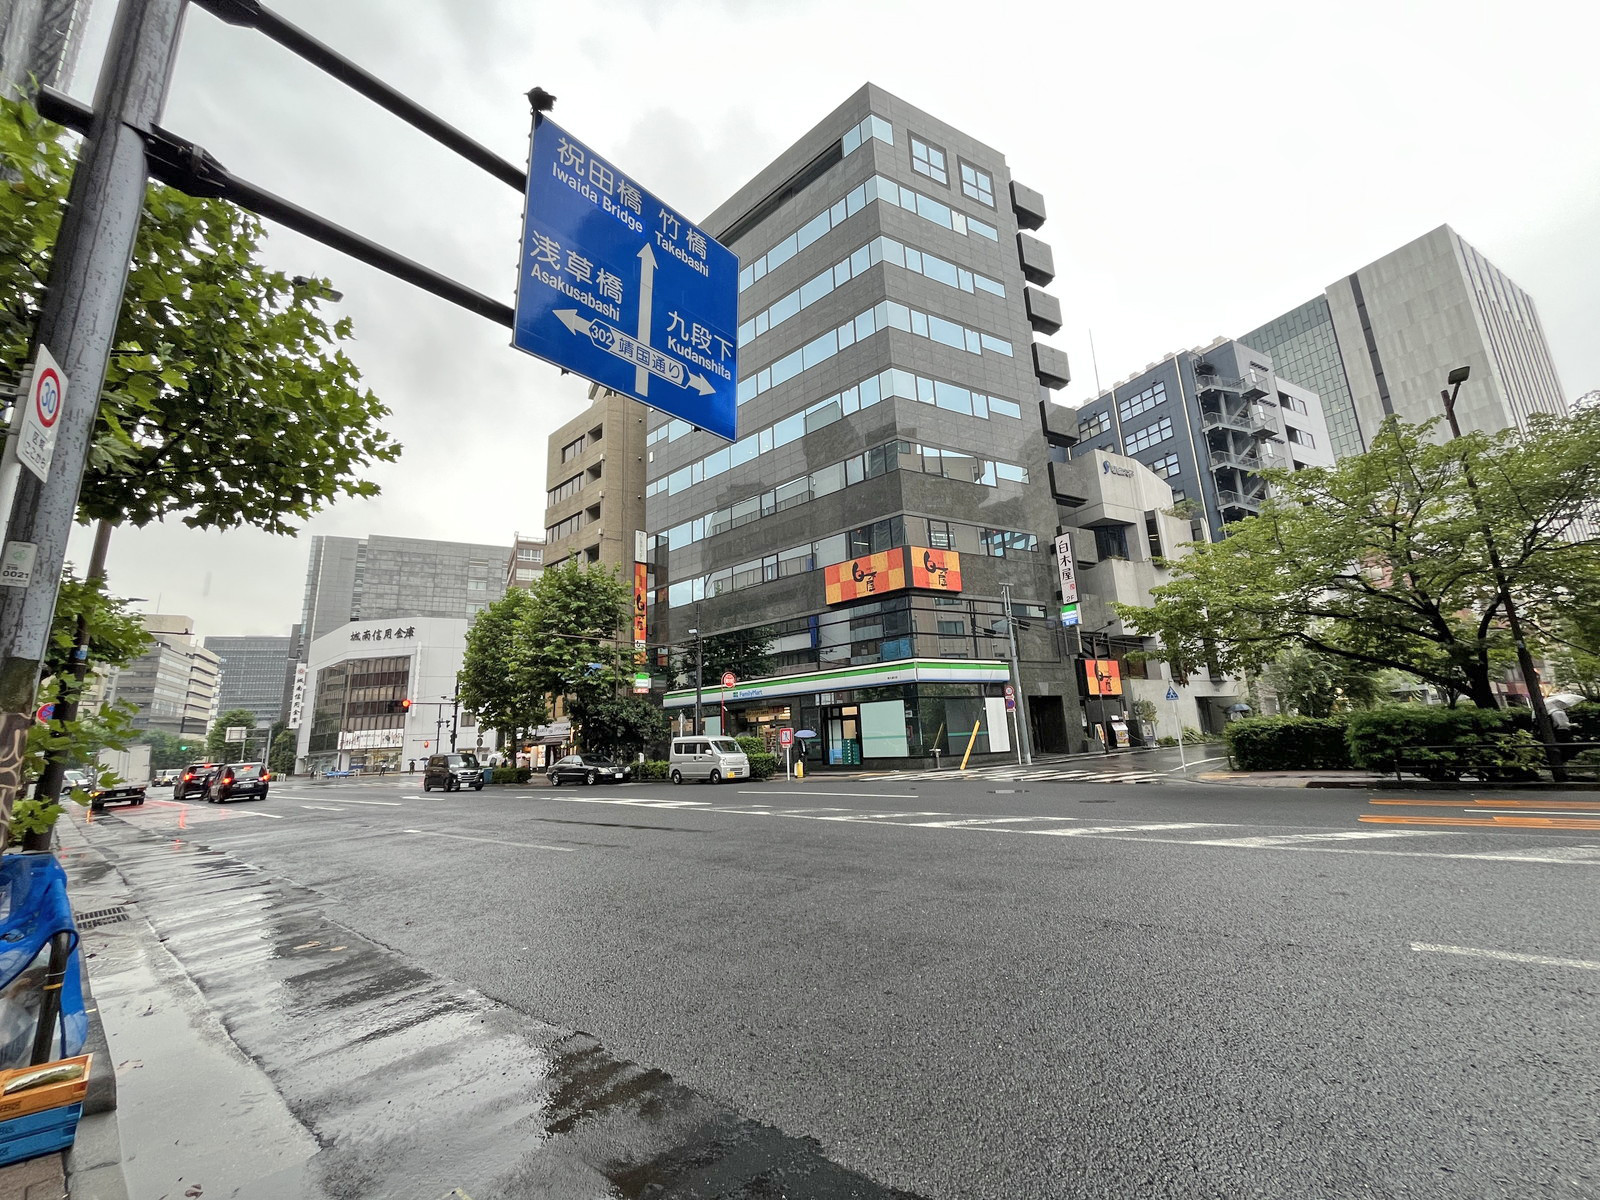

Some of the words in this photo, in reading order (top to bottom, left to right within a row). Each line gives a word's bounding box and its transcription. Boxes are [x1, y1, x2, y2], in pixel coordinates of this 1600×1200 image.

[552, 161, 598, 203] Iwaida
[602, 195, 644, 234] Bridge
[556, 137, 643, 216] 祝田橋
[654, 230, 709, 278] Takebashi
[658, 208, 707, 261] 竹橋
[530, 230, 624, 305] 浅草橋
[531, 263, 620, 322] Asakusabashi
[592, 326, 613, 346] 302
[666, 310, 733, 362] 九段下
[618, 337, 682, 380] 靖国通り
[667, 336, 732, 381] Kudanshita
[42, 381, 57, 413] 30
[2, 570, 29, 579] 0021
[1058, 540, 1074, 581] 白木屋
[1066, 594, 1075, 603] 2F
[350, 626, 415, 641] 城南信用金庫
[739, 689, 763, 698] FamilyMart
